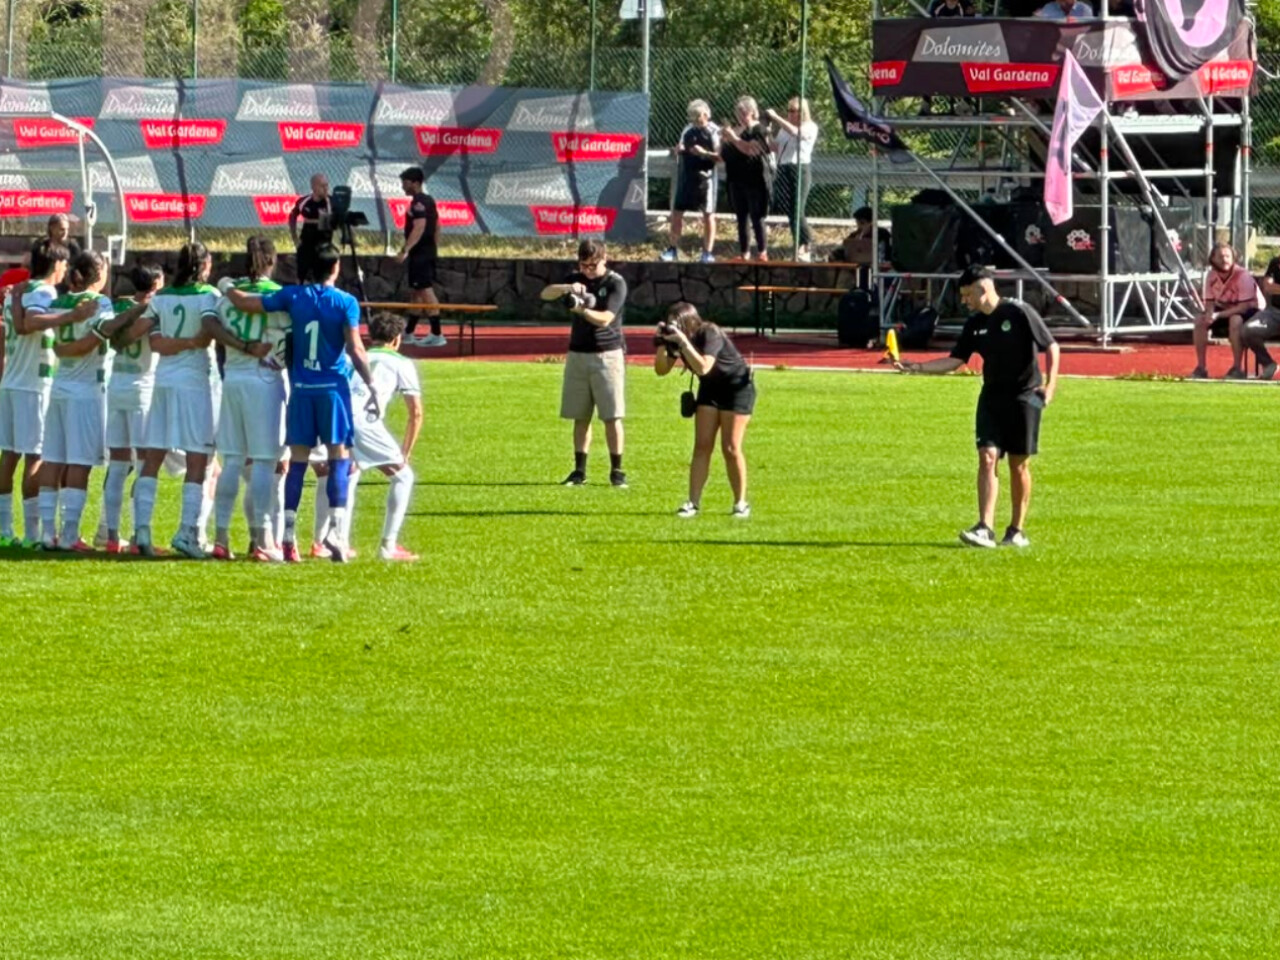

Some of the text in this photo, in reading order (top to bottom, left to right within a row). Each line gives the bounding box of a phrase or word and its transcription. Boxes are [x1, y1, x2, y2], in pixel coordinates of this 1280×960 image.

[921, 35, 1001, 57] Dolomites
[969, 68, 1049, 82] Val Gardena
[106, 94, 176, 114] Dolomites
[244, 96, 313, 117] Dolomites
[20, 126, 38, 138] Val
[147, 124, 218, 138] Val Gardena
[284, 127, 355, 141] Val Gardena
[421, 132, 492, 147] Val Gardena
[559, 136, 632, 152] Val Gardena
[218, 170, 287, 192] Dolomites
[493, 181, 567, 200] Dolomites
[18, 196, 65, 209] Gardena
[130, 198, 148, 211] Val
[261, 201, 280, 214] Val
[539, 210, 557, 223] Val
[305, 320, 319, 360] 1
